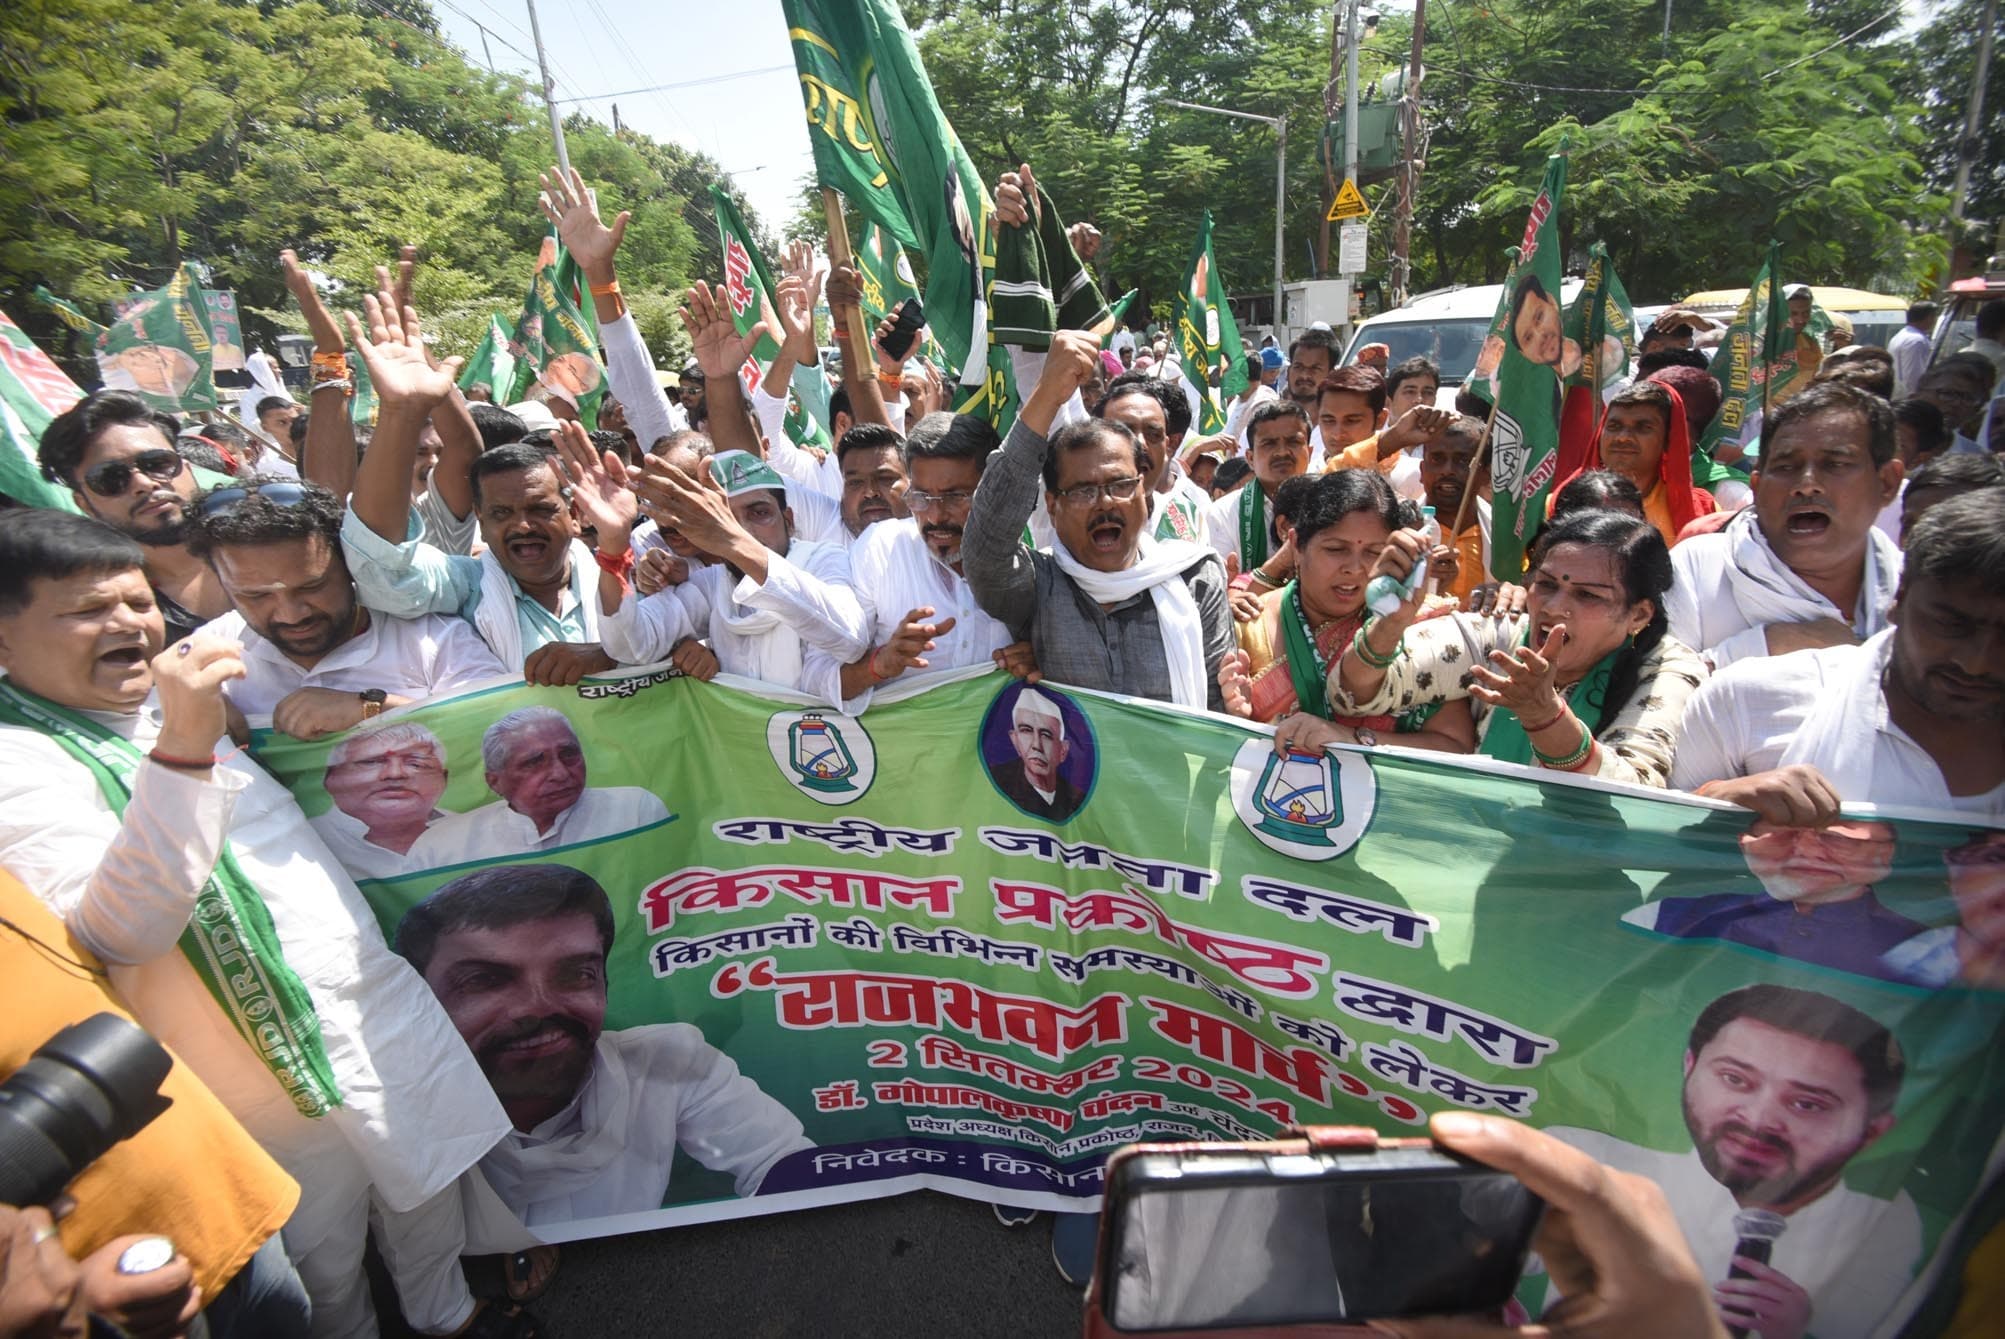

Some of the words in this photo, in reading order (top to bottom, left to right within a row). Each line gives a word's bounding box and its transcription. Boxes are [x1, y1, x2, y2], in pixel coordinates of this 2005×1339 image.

[579, 676, 651, 697] राष्ट्रीय
[718, 820, 955, 853] राष्ट्रीय
[982, 829, 1213, 896] जनता
[1249, 879, 1430, 942] दल
[211, 923, 260, 1000] RJD
[643, 870, 959, 931] किसान
[993, 883, 1323, 993] प्रकोष्ठ
[1339, 976, 1551, 1065] द्वारा
[654, 916, 815, 973] किसानों
[829, 919, 880, 949] की
[893, 926, 1038, 967] विभिन्न
[1050, 948, 1258, 1017] समस्याओं
[1275, 1014, 1348, 1058] को
[1369, 1044, 1529, 1114] लेकर
[716, 960, 1127, 1058] “राजभवन
[815, 1084, 866, 1110] डॉ.
[875, 1080, 1076, 1132] गोपालकृष्ण
[1081, 1093, 1163, 1119] चंदन
[869, 1042, 903, 1065] 2
[920, 1037, 1119, 1095] सितम्बर
[1134, 1058, 1296, 1126] 2024
[811, 1148, 946, 1174] निवेदक
[957, 1153, 967, 1165] :
[980, 1152, 1104, 1188] किसान
[911, 1116, 951, 1132] प्रदेश
[959, 1120, 1013, 1138] अध्यक्ष
[1018, 1129, 1071, 1156] किसान
[1077, 1127, 1139, 1150] प्रकोष्ठ,
